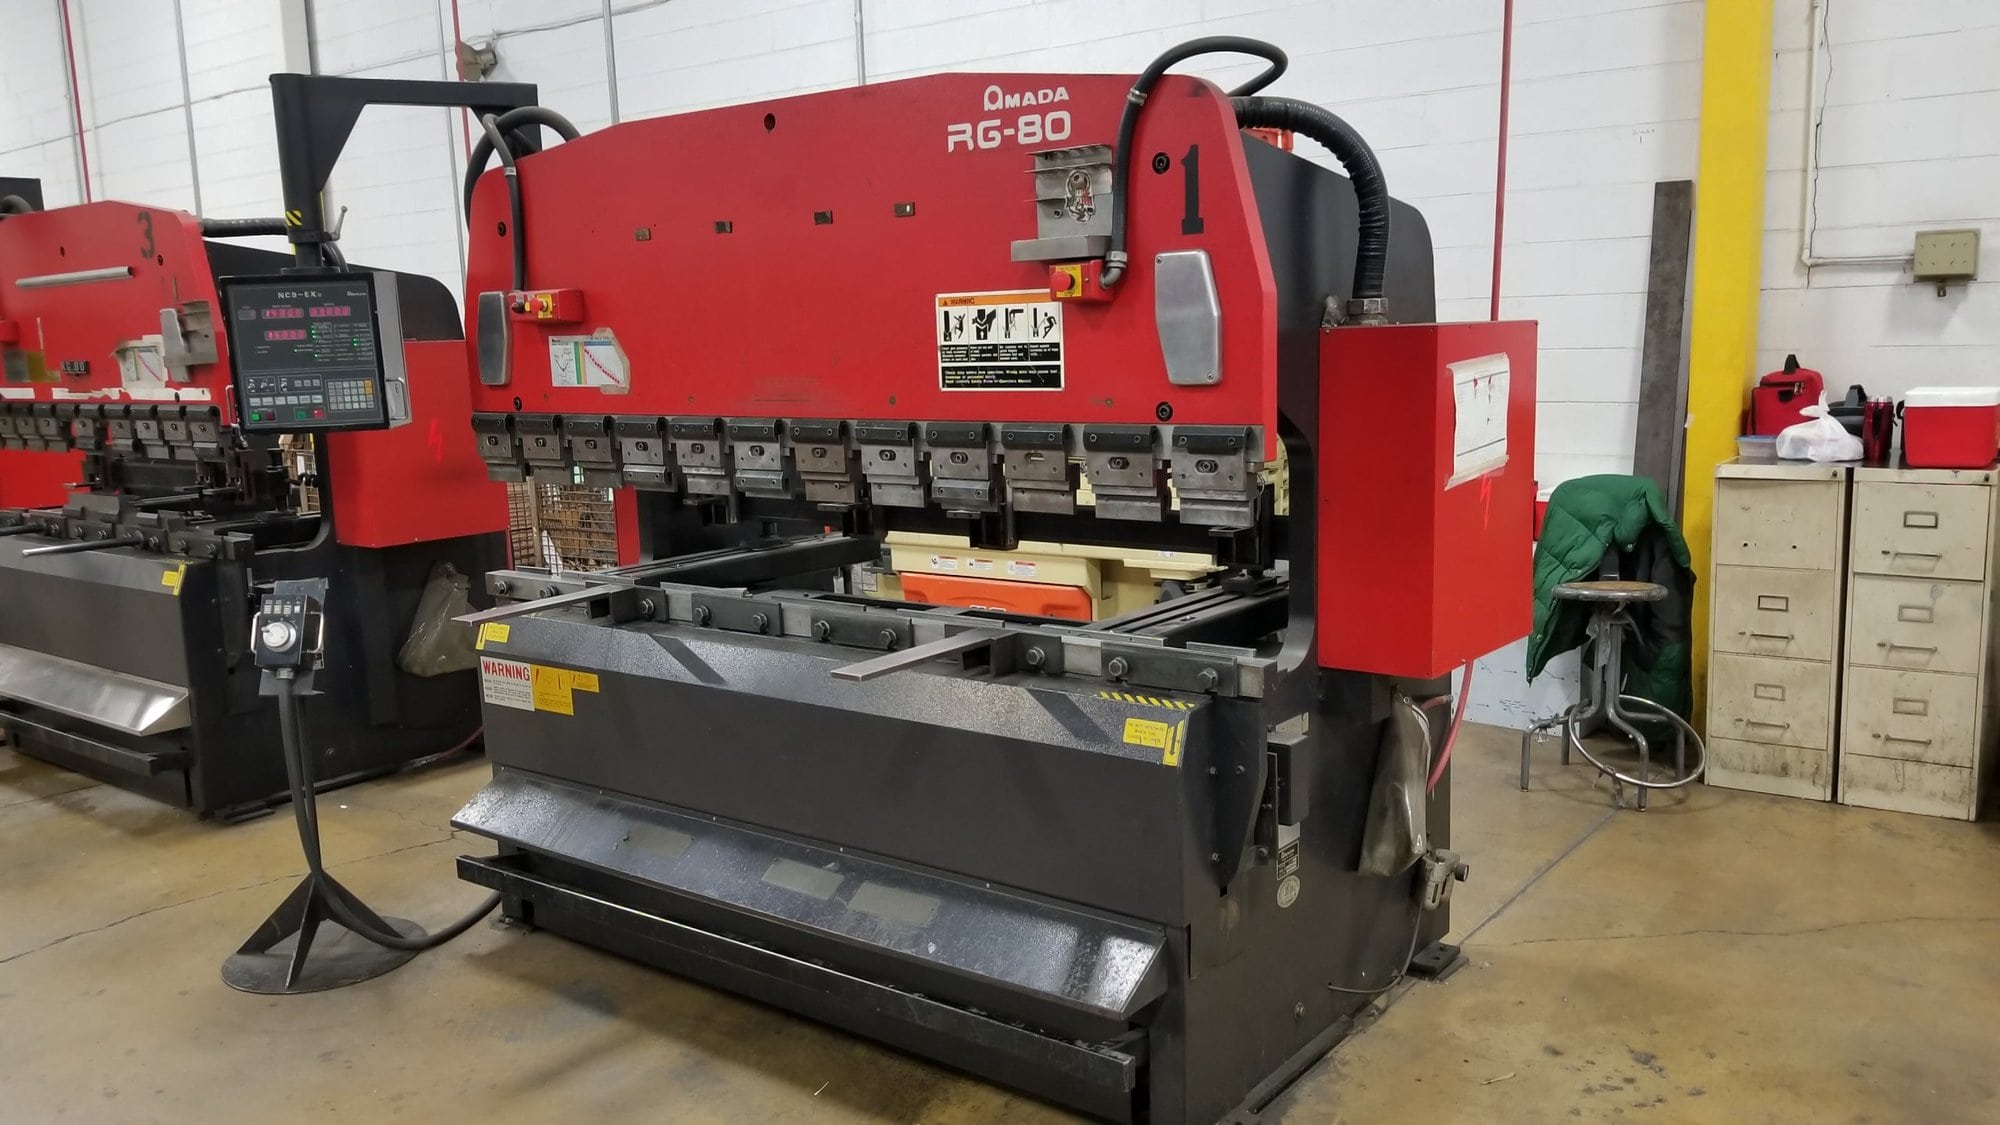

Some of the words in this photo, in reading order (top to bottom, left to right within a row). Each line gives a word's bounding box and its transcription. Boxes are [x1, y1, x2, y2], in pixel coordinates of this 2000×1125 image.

[984, 85, 1070, 112] AMADA
[947, 110, 1072, 153] RG-80
[1181, 143, 1205, 236] 1
[137, 211, 155, 260] 3
[482, 660, 531, 682] WARNING
